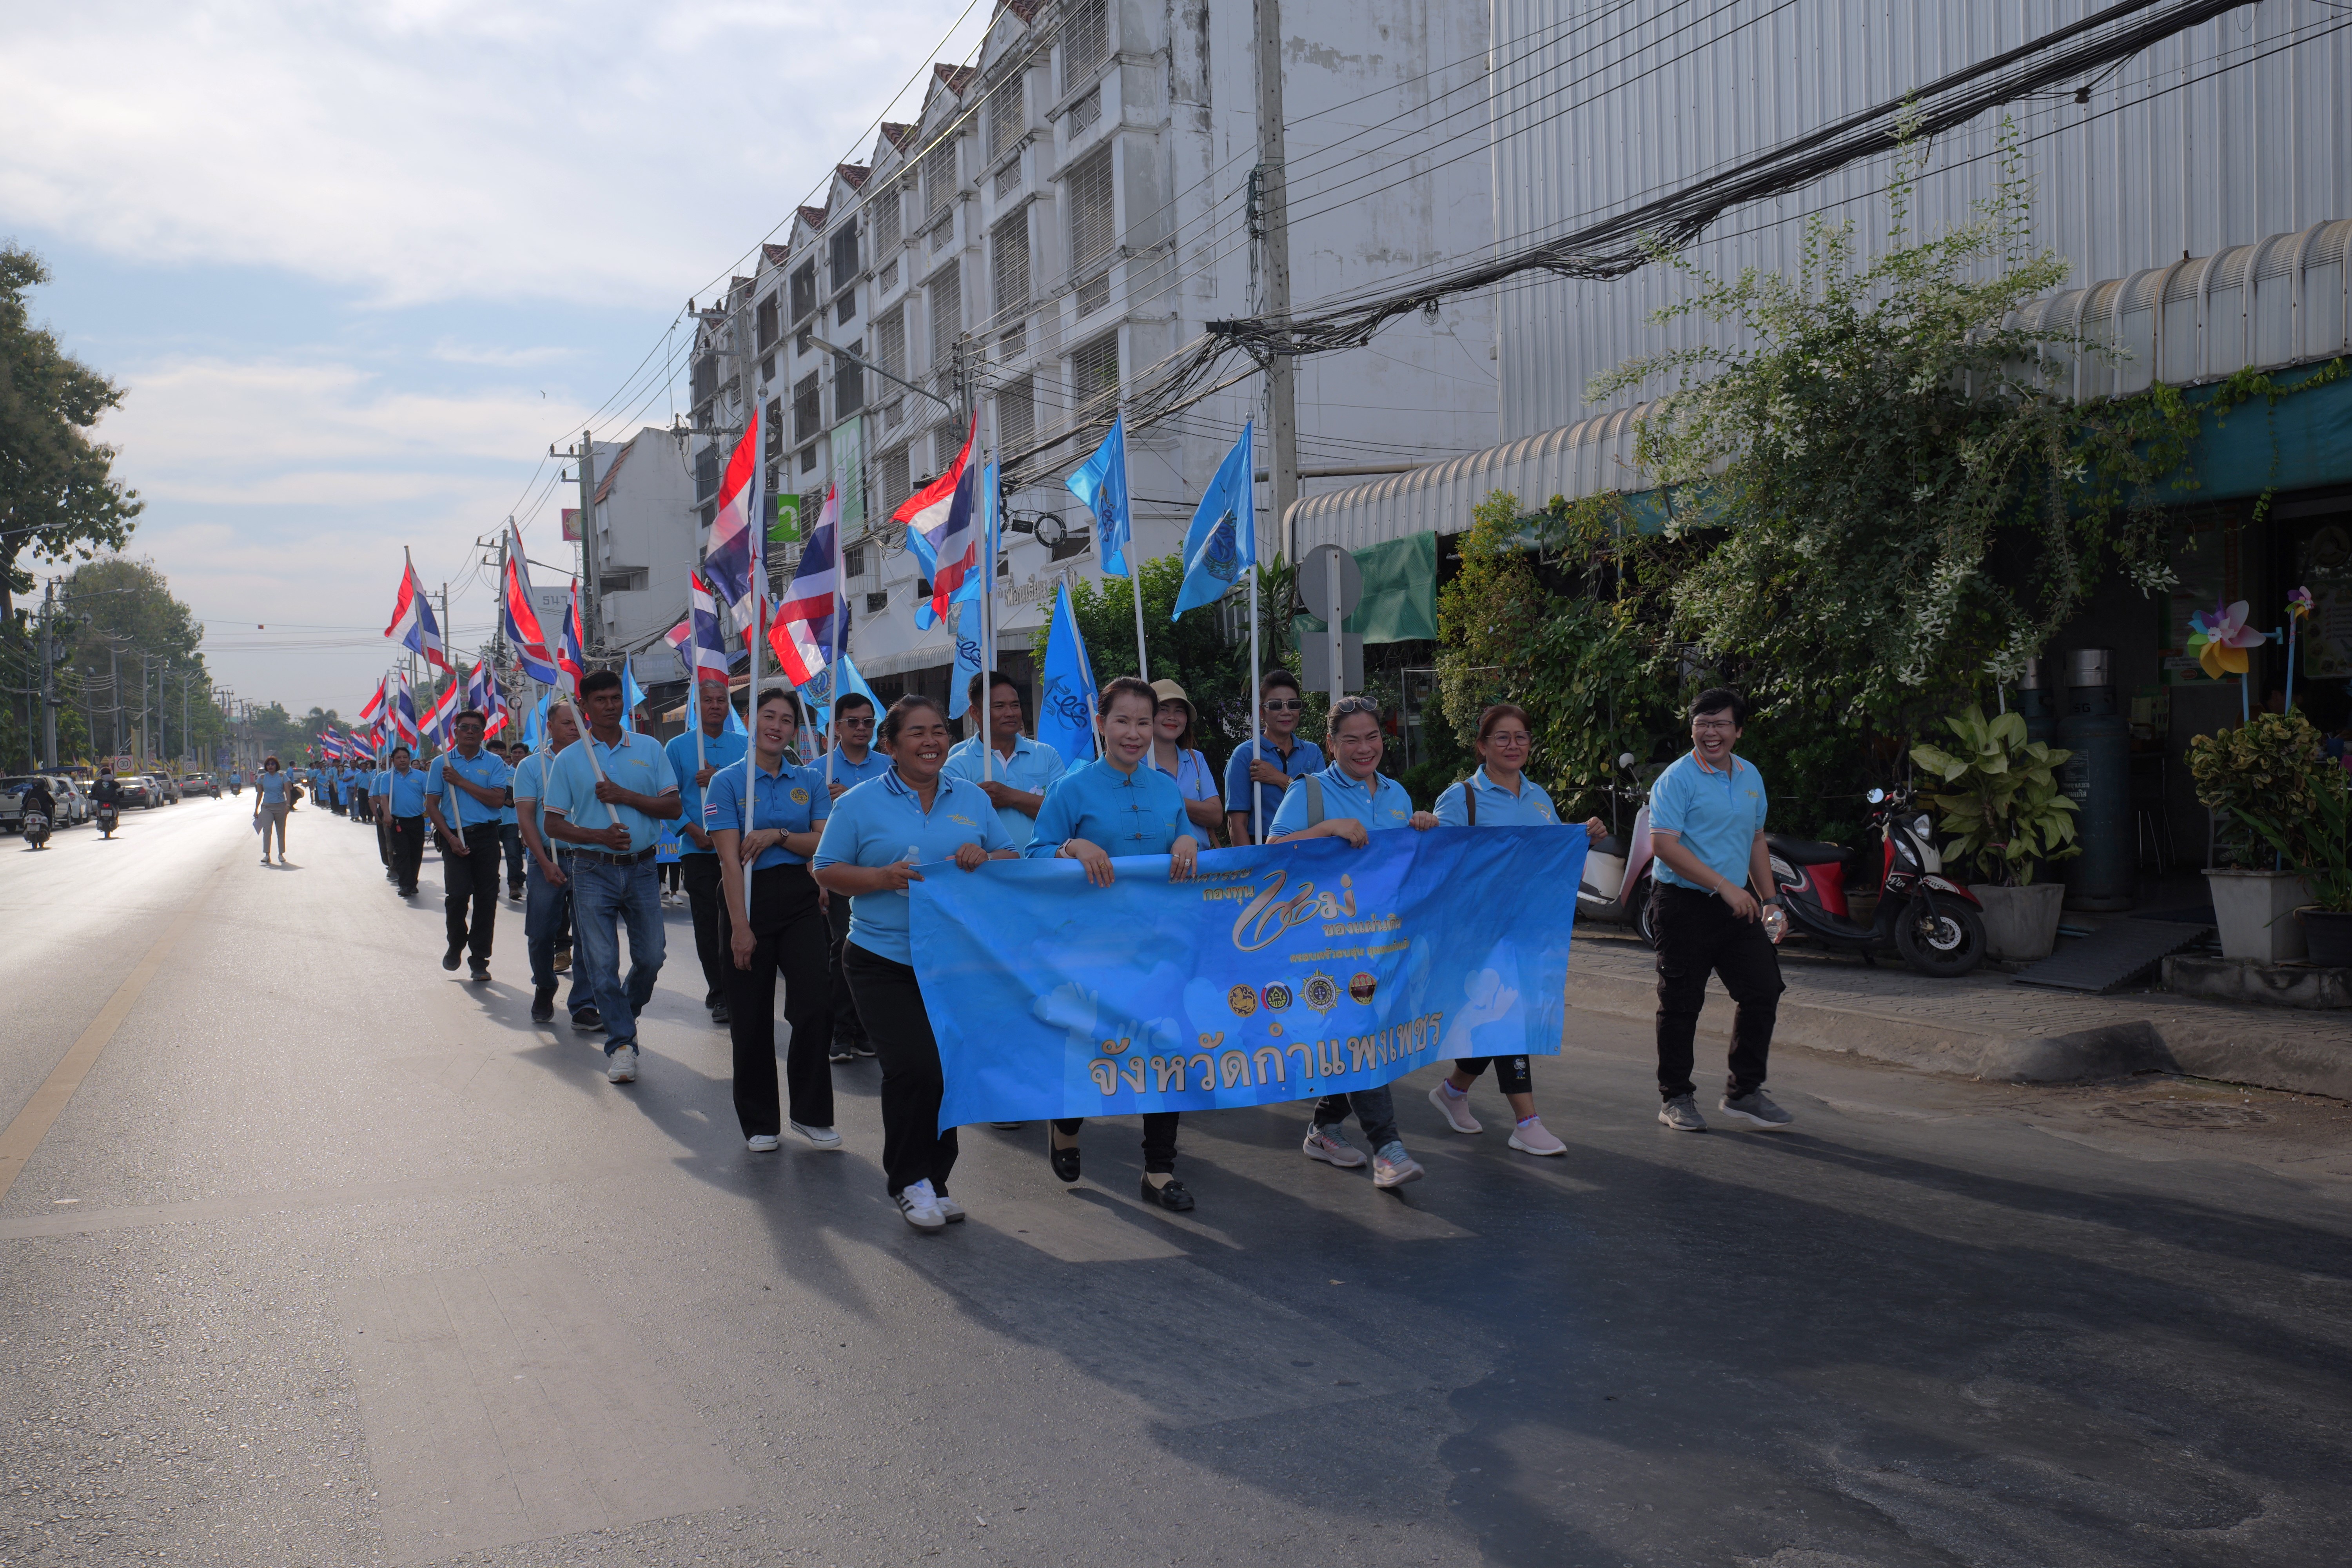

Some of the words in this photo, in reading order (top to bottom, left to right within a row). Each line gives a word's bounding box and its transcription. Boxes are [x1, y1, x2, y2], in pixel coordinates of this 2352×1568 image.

[2074, 703, 2091, 712] SG
[1889, 876, 1906, 887] Vin
[1203, 885, 1254, 906] กองทุน
[1322, 913, 1403, 937] ของแผ่นดิน
[1290, 944, 1365, 963] ครอบครัวอบอุ่น
[1088, 1012, 1443, 1096] จังหวัดกำแพงเพชร
